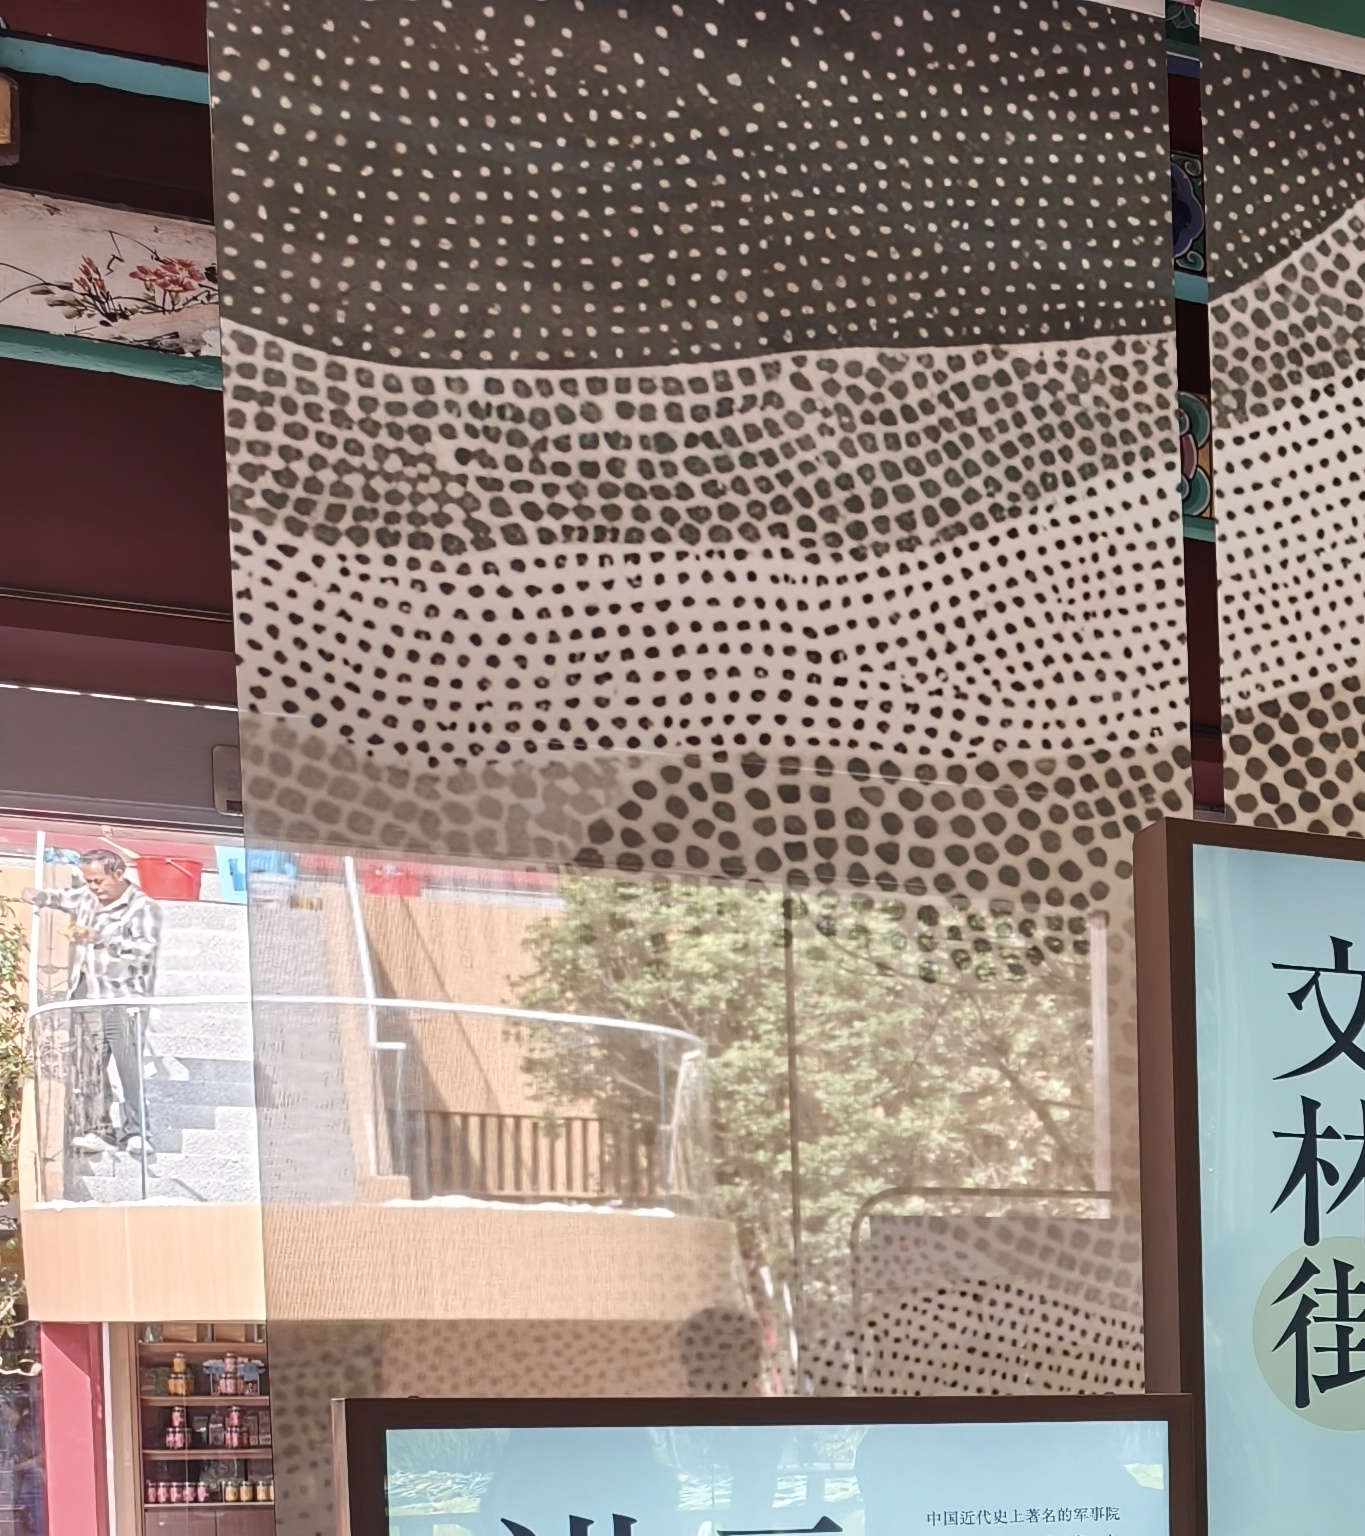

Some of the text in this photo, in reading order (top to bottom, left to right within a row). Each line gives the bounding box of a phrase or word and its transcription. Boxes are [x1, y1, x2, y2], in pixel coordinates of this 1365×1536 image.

[926, 1506, 1121, 1527] 中国近代史上著名的军事院
